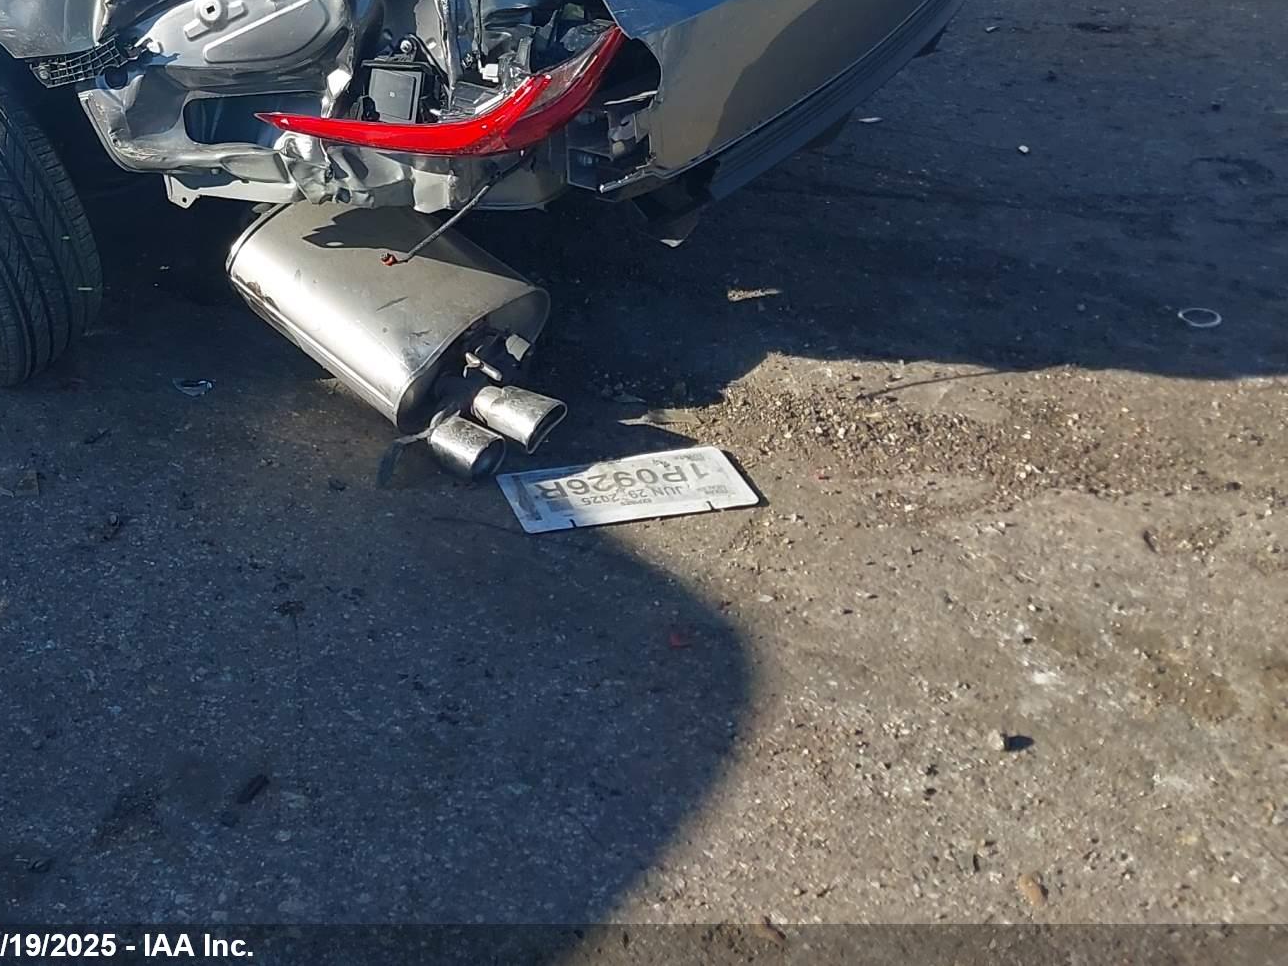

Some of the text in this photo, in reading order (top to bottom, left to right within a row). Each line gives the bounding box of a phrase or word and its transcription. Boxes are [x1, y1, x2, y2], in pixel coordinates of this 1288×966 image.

[535, 463, 709, 500] 1P0926R
[650, 485, 683, 498] JUN
[581, 492, 619, 506] 2025
